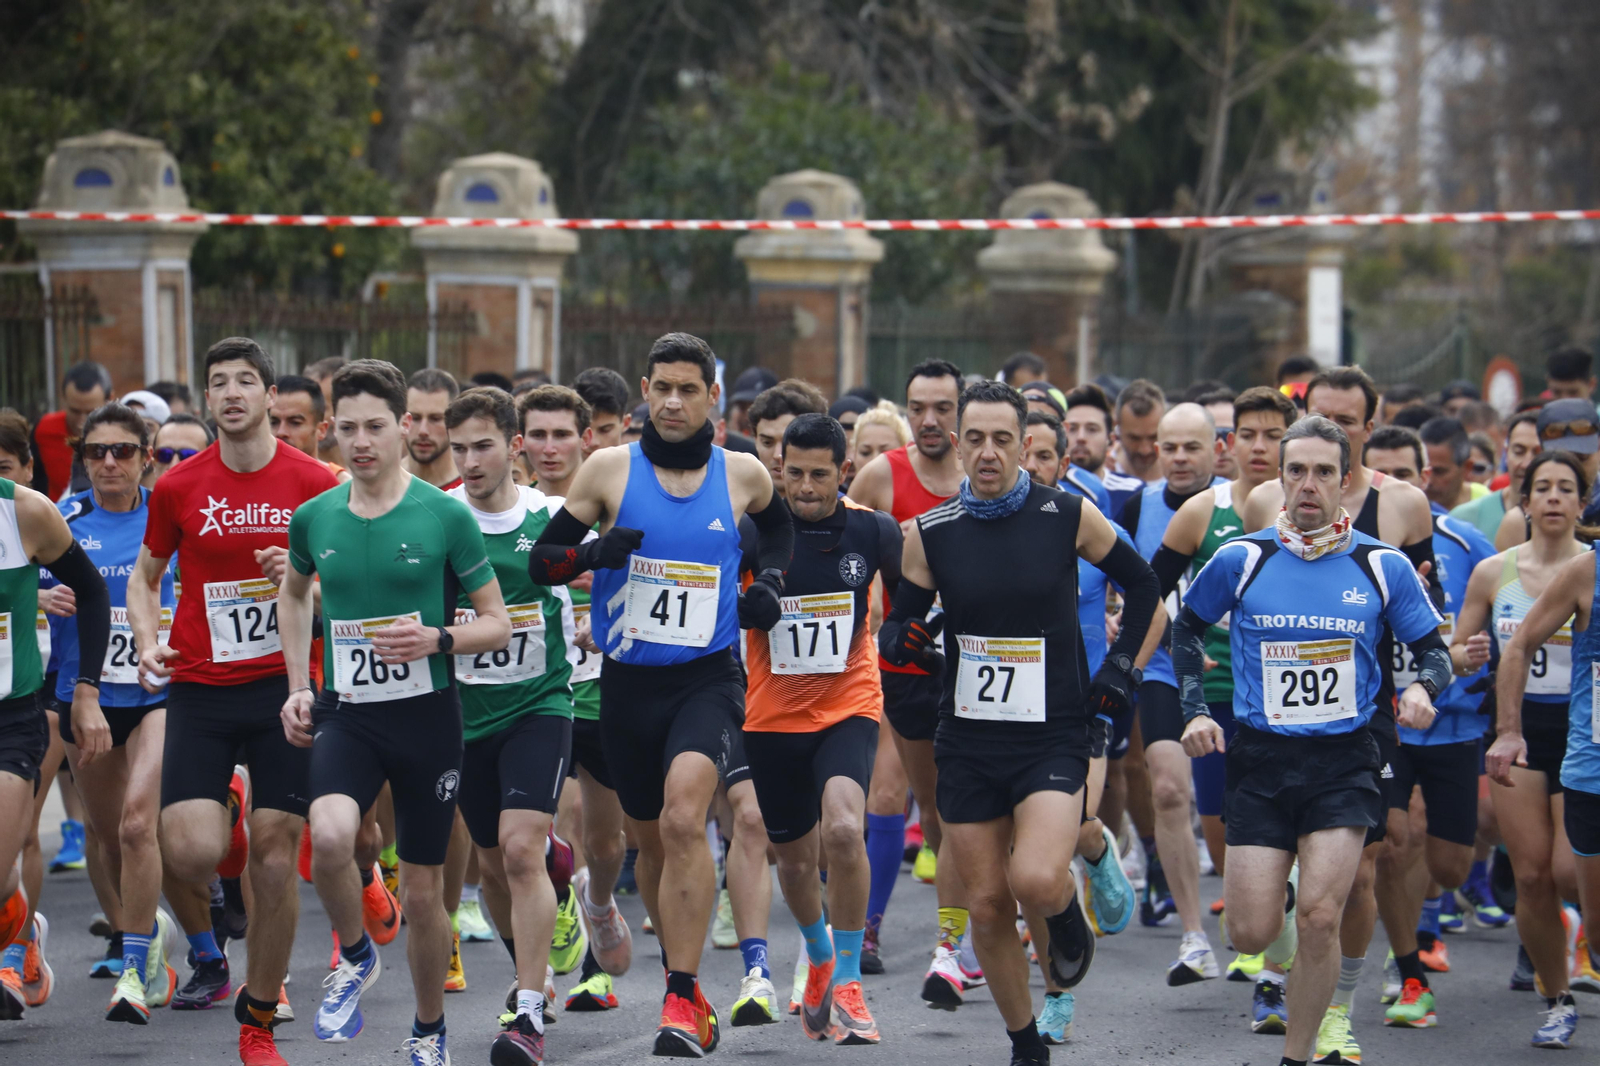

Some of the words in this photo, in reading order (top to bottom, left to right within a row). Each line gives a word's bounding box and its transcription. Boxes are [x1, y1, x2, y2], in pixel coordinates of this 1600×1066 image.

[221, 502, 293, 526] califas
[632, 558, 666, 577] XXXIX
[208, 584, 241, 600] XXXIX
[679, 581, 716, 589] TRINITARIOS
[650, 589, 688, 628] 41
[780, 599, 801, 613] XIX
[228, 602, 279, 643] 124
[334, 623, 363, 637] XXXIX
[1252, 614, 1366, 634] TROTASIERRA
[788, 621, 838, 657] 171
[960, 637, 987, 654] XXXIX
[1265, 645, 1298, 658] XXXIX
[978, 665, 1015, 703] 27
[1281, 667, 1339, 707] 292
